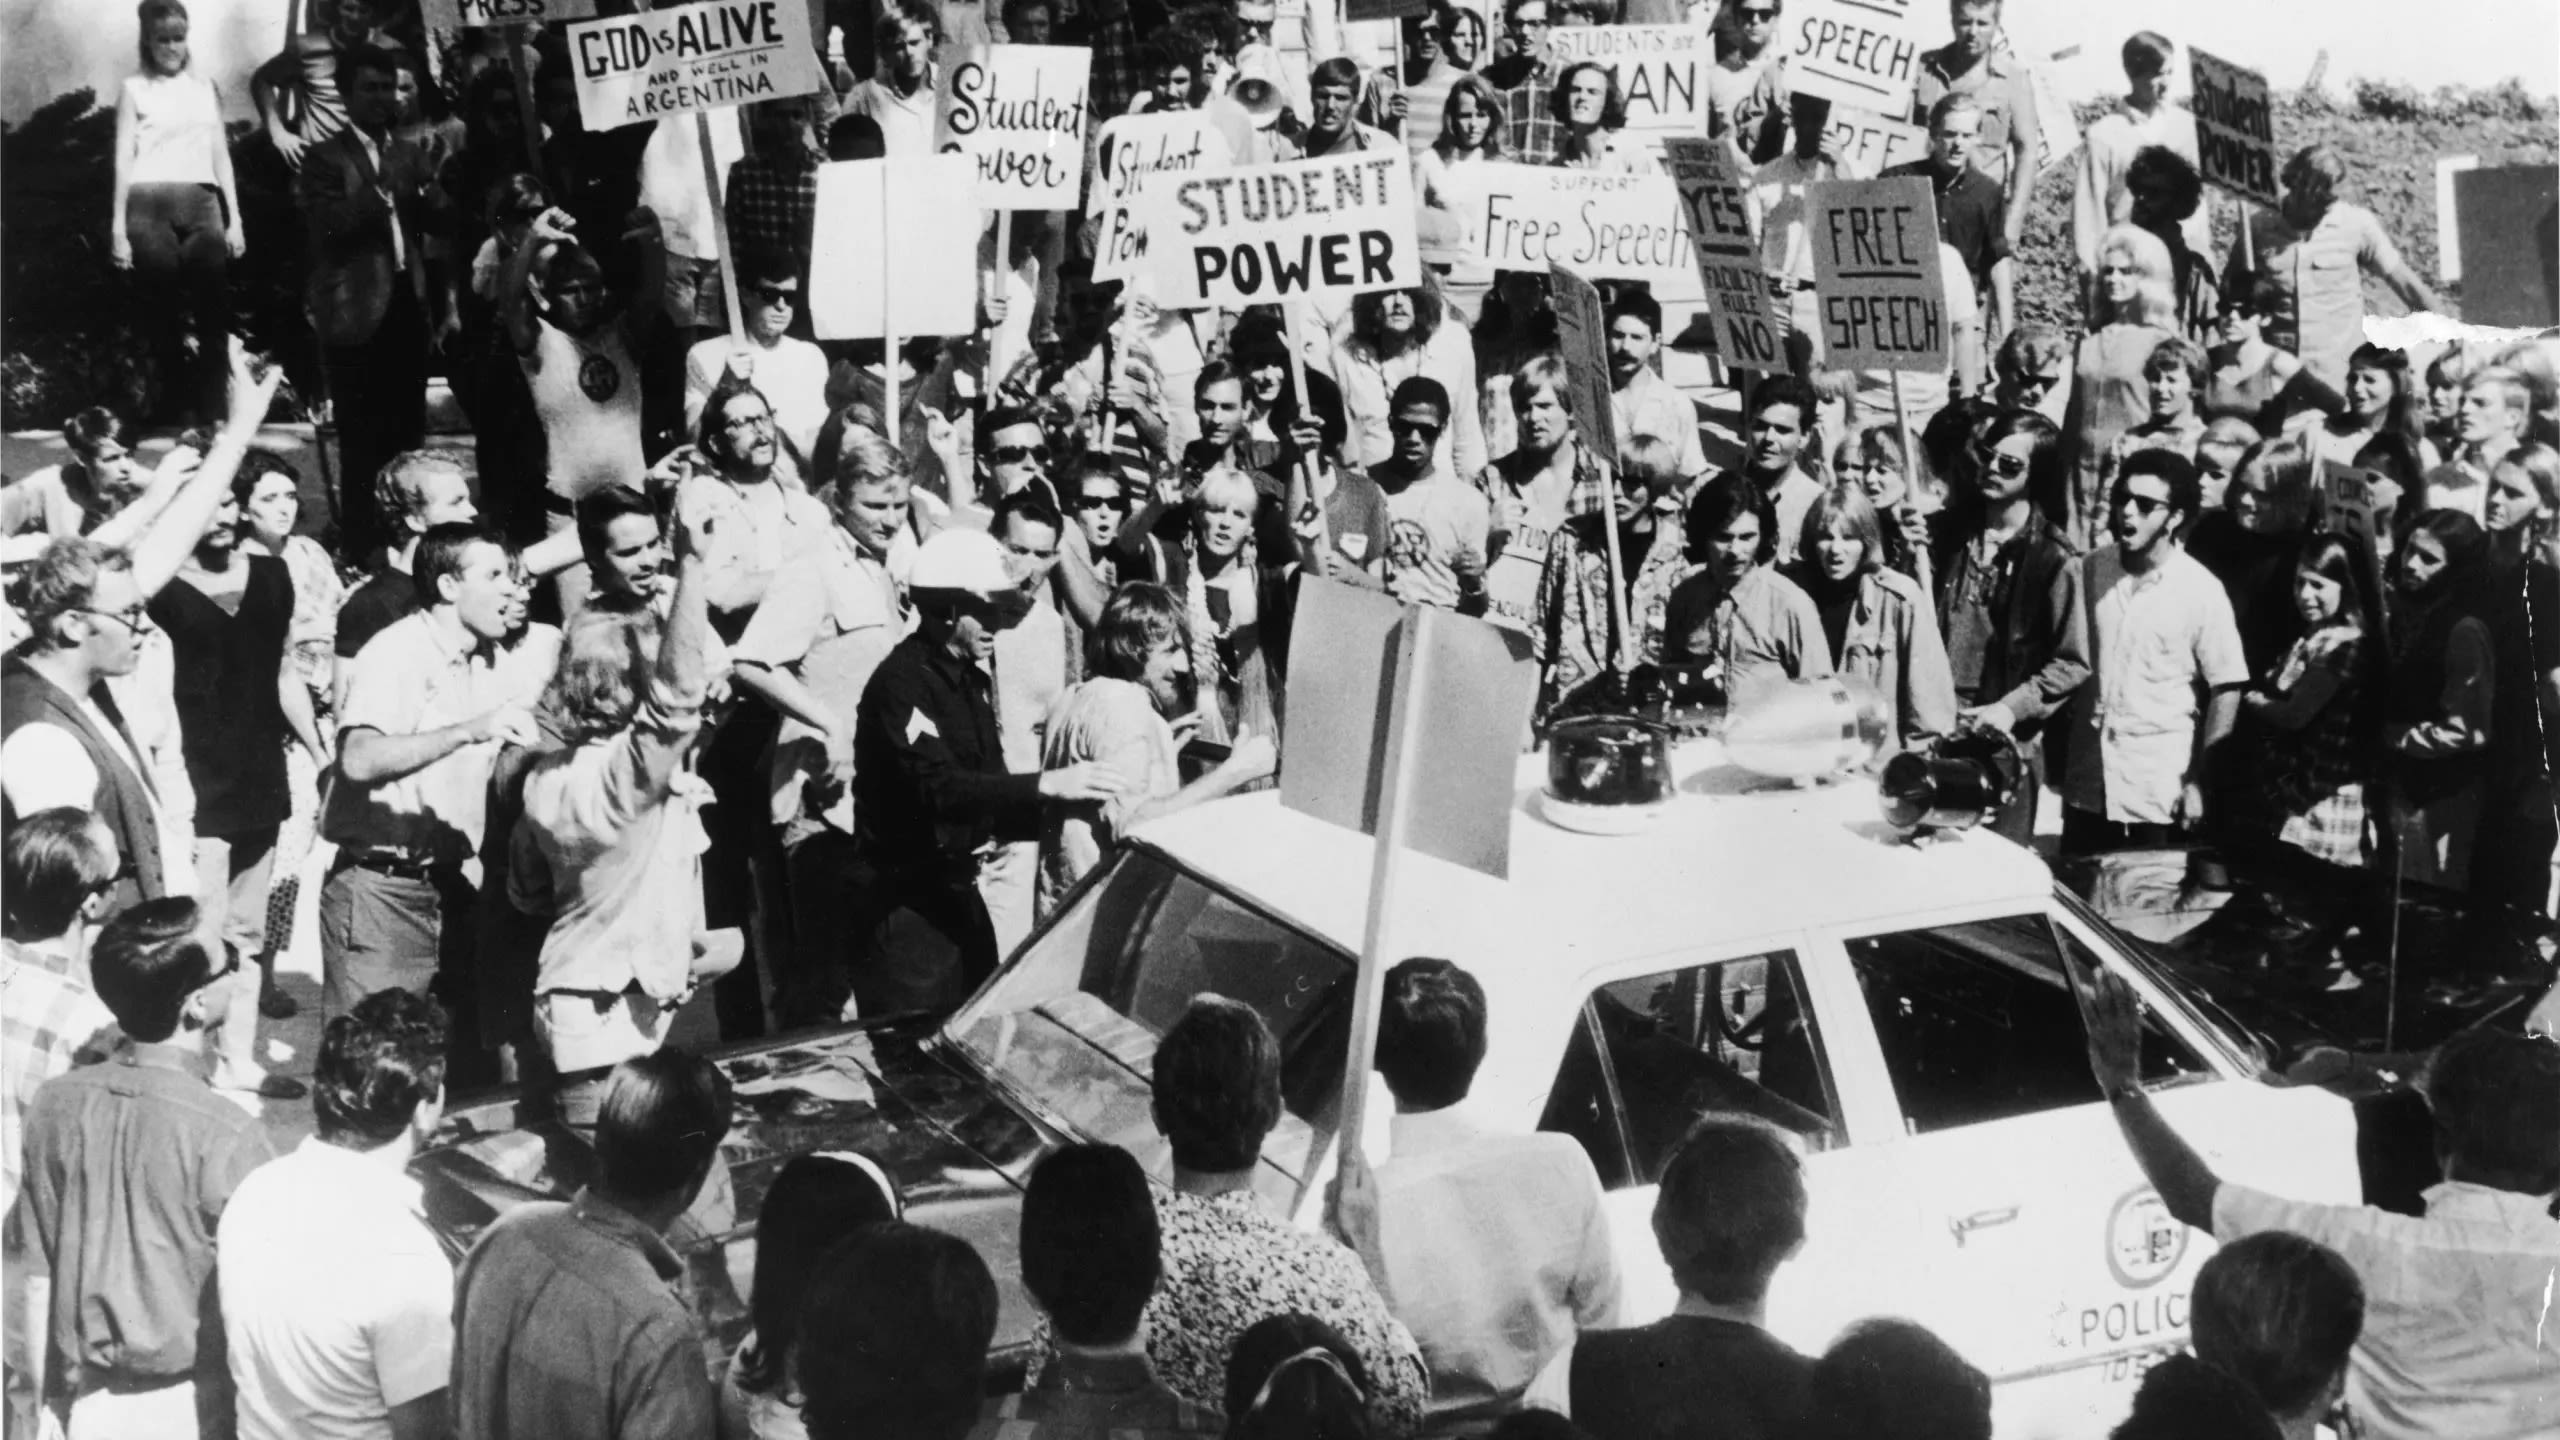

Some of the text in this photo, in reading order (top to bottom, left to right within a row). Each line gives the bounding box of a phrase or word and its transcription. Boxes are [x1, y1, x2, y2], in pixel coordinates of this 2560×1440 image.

[579, 25, 650, 77] GOD
[678, 2, 783, 57] ALIVE
[1557, 30, 1665, 56] STUDENTS
[1795, 17, 1914, 81] SPEECH
[626, 72, 774, 117] ARGENTINA
[649, 53, 768, 86] AND WELL IN
[1608, 61, 1695, 114] AN
[949, 62, 1083, 139] Student
[1177, 159, 1394, 234] STUDENT
[1550, 175, 1640, 192] SUPPORT
[1485, 194, 1562, 262] Free
[1678, 186, 1749, 236] YES
[1828, 206, 1919, 266] FREE
[1194, 230, 1394, 298] POWER
[1703, 265, 1764, 296] FACULTY
[1720, 292, 1761, 316] RULE
[1826, 296, 1939, 352] SPEECH
[1727, 316, 1774, 362] NO
[2081, 1293, 2187, 1348] POLIC
